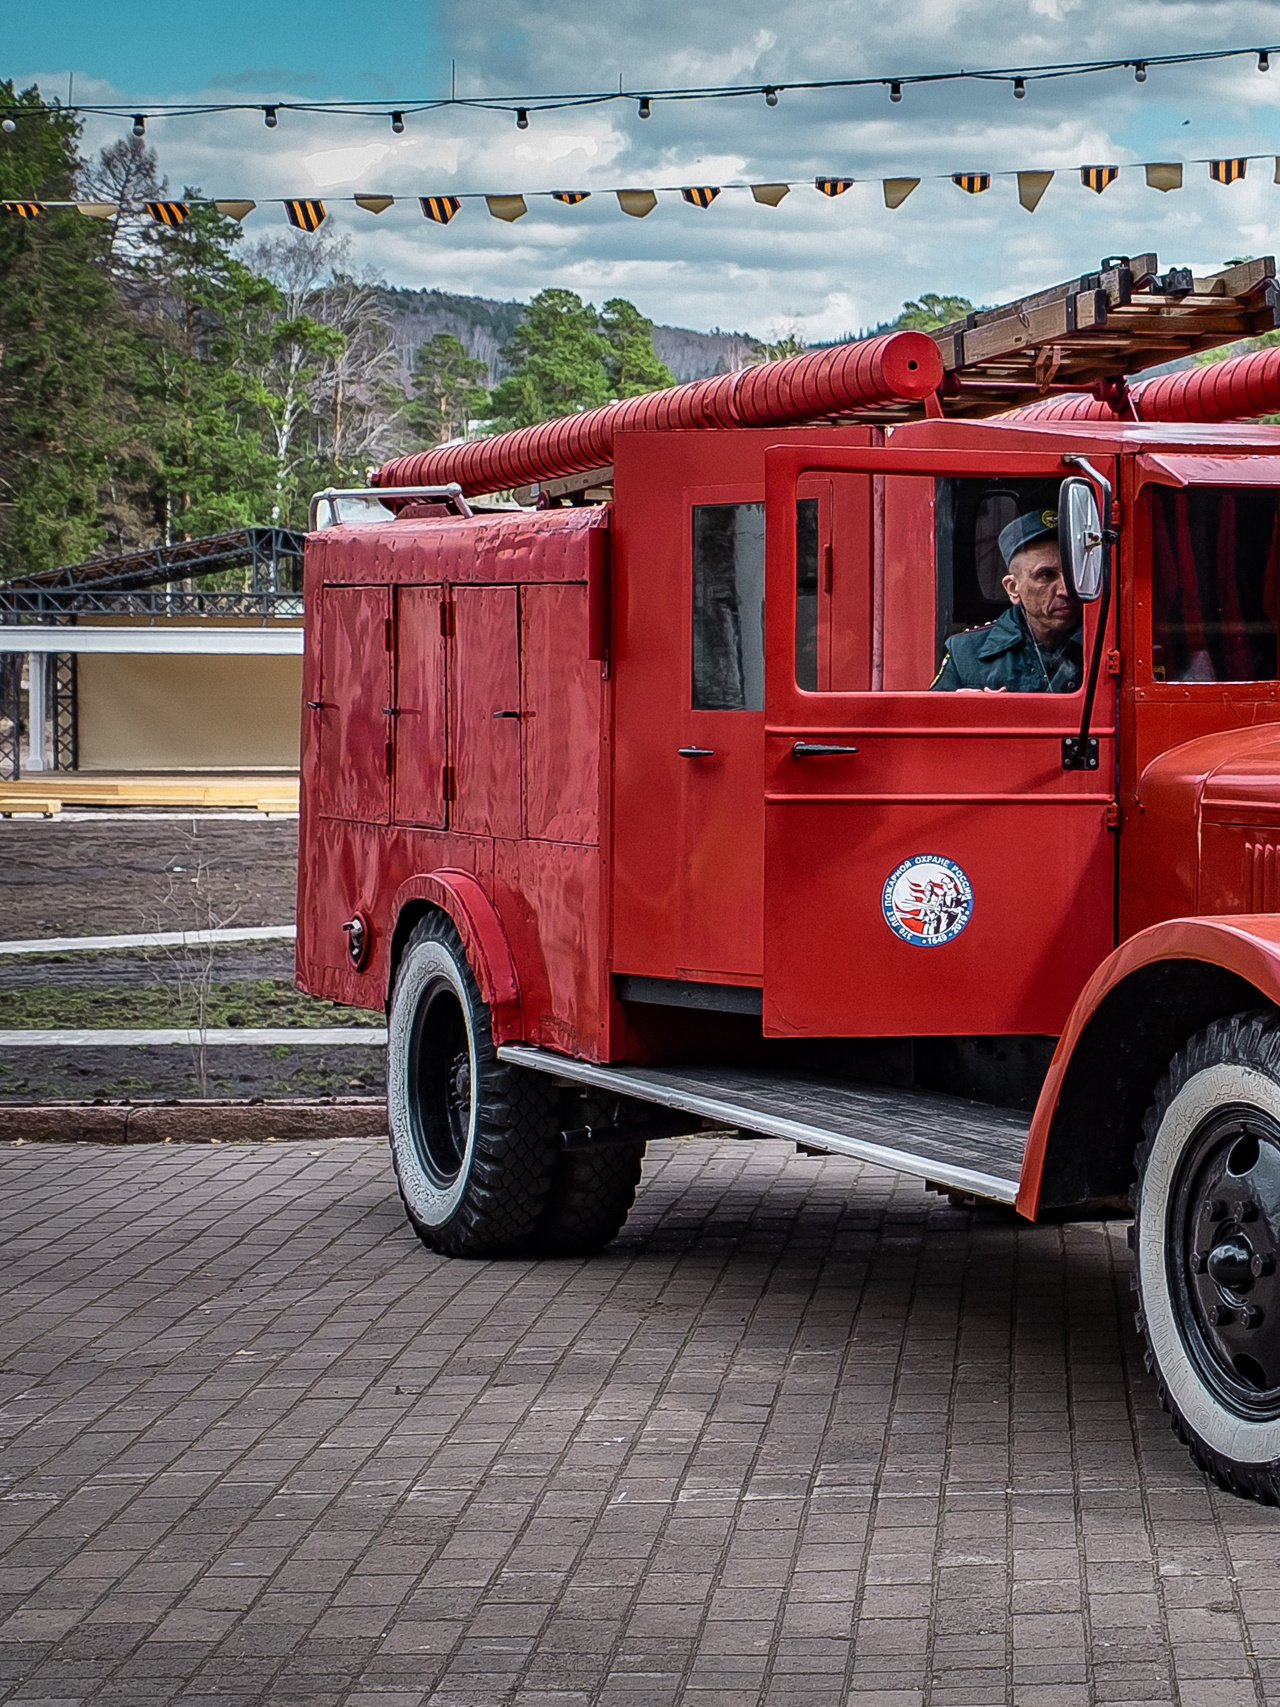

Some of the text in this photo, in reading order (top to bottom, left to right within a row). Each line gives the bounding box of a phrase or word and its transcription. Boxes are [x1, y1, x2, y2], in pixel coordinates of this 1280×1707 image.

[884, 855, 972, 940] 370 ЛЕТ ПОЖАРНОЙ ОХРАНЕ РОССИИ
[951, 915, 968, 934] 2019
